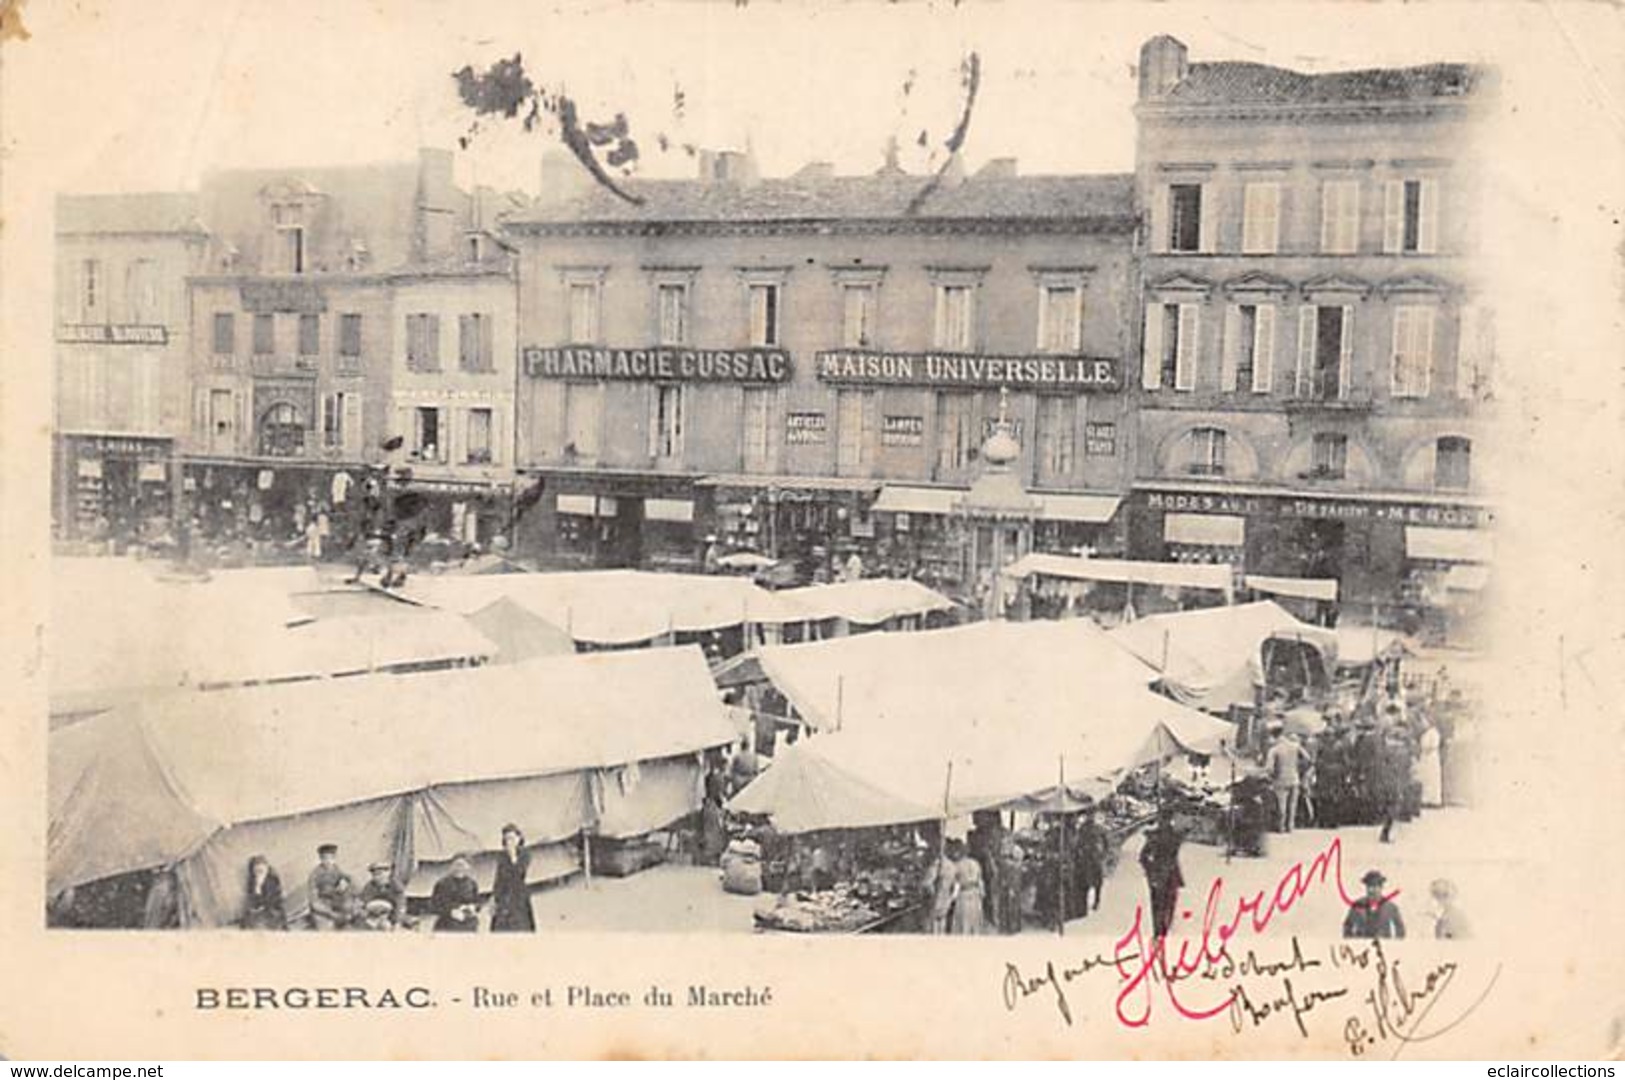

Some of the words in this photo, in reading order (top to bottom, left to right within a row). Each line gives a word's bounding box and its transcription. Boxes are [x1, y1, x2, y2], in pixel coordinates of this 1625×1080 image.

[526, 350, 673, 376] PHARMACIE
[681, 352, 786, 379] CUSSAC
[821, 355, 912, 378] MAISON
[926, 356, 1116, 384] UNIVERSELLE.
[1148, 493, 1214, 510] MODES
